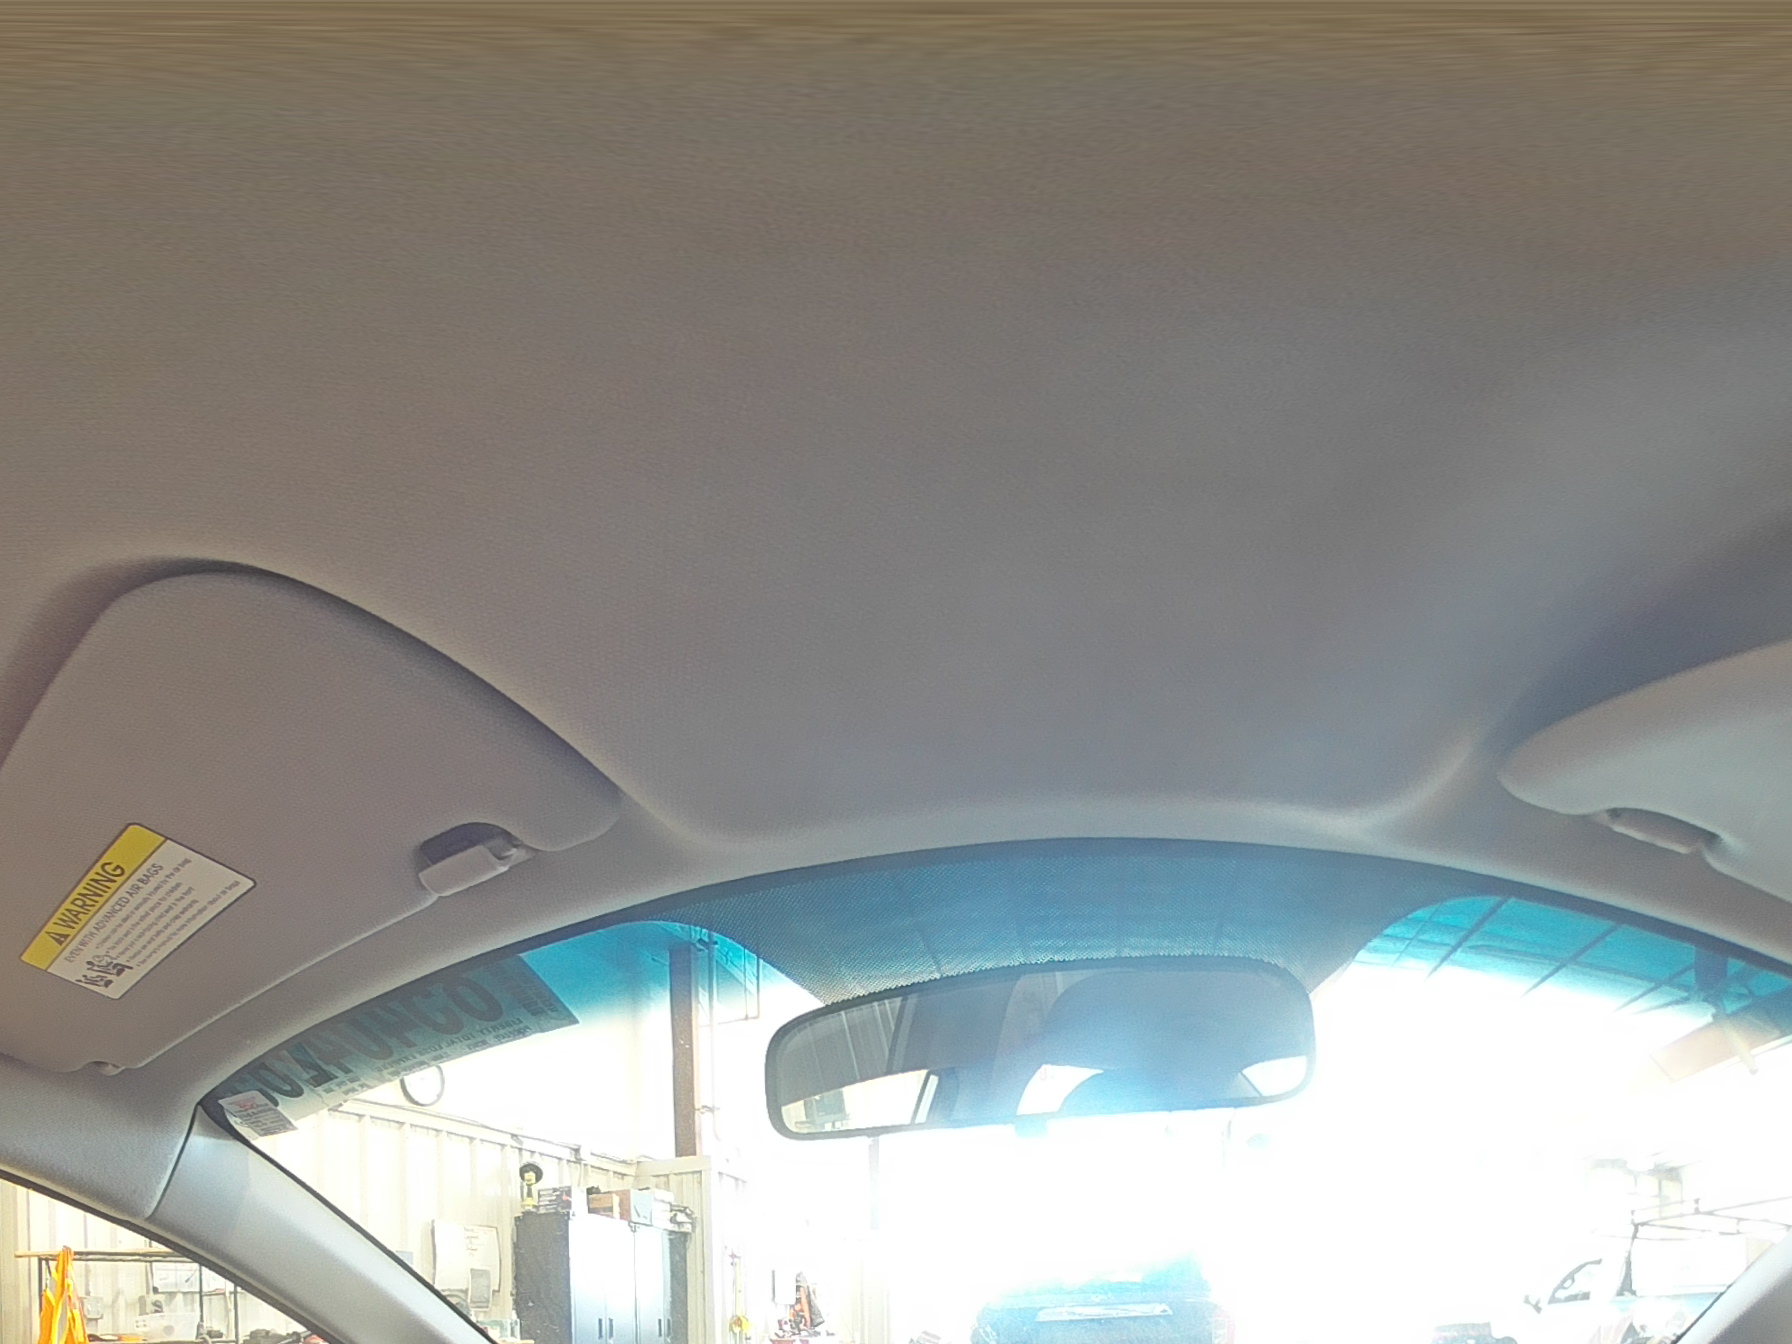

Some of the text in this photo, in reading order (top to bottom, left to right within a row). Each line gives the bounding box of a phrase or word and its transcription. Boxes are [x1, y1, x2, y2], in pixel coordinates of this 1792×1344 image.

[52, 858, 128, 932] WARNING
[62, 862, 164, 962] EVEN WITH ADVANCED AIR BAGS
